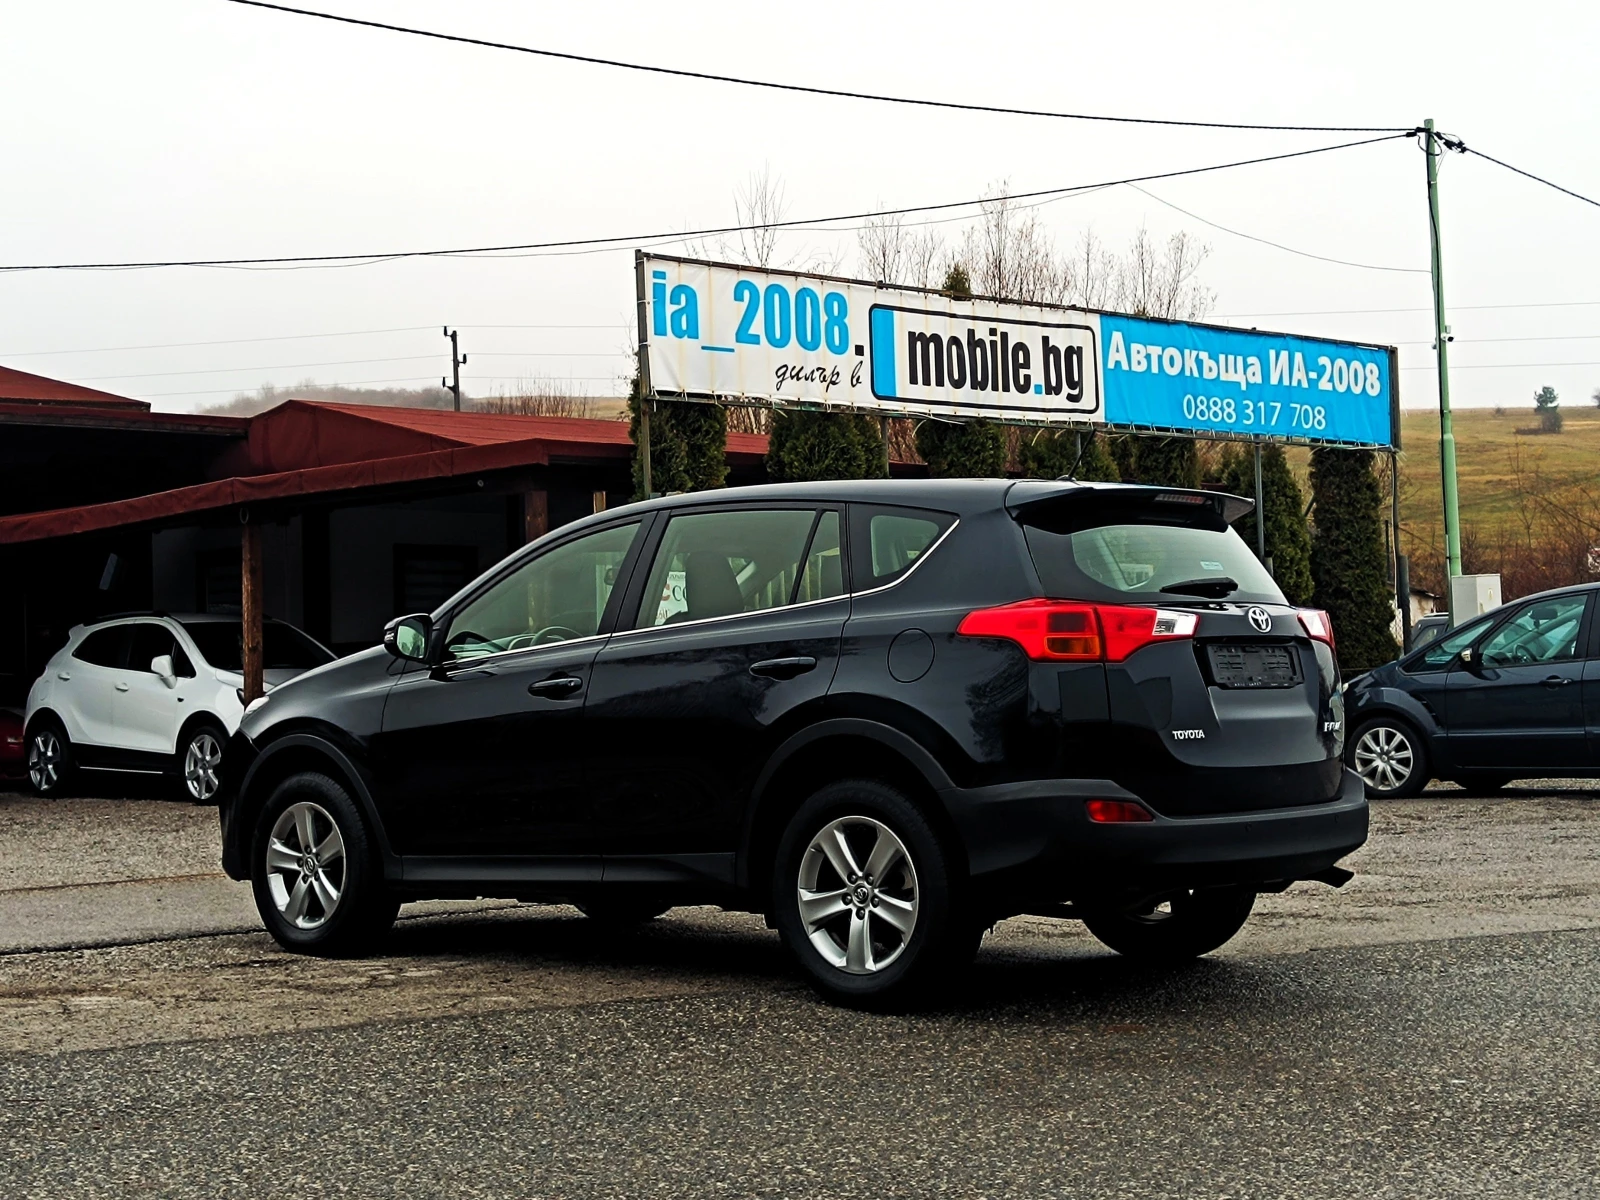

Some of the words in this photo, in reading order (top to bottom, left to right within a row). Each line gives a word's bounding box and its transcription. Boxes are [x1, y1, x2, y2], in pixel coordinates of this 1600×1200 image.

[775, 363, 841, 393] дилър
[908, 328, 1083, 402] mobile.bg
[1107, 331, 1262, 390] Автокъща
[1269, 349, 1381, 397] ИА-2008
[1183, 394, 1237, 424] 0888
[1242, 400, 1282, 428] 317
[1290, 403, 1327, 430] 708
[1172, 729, 1205, 740] TOYOTA
